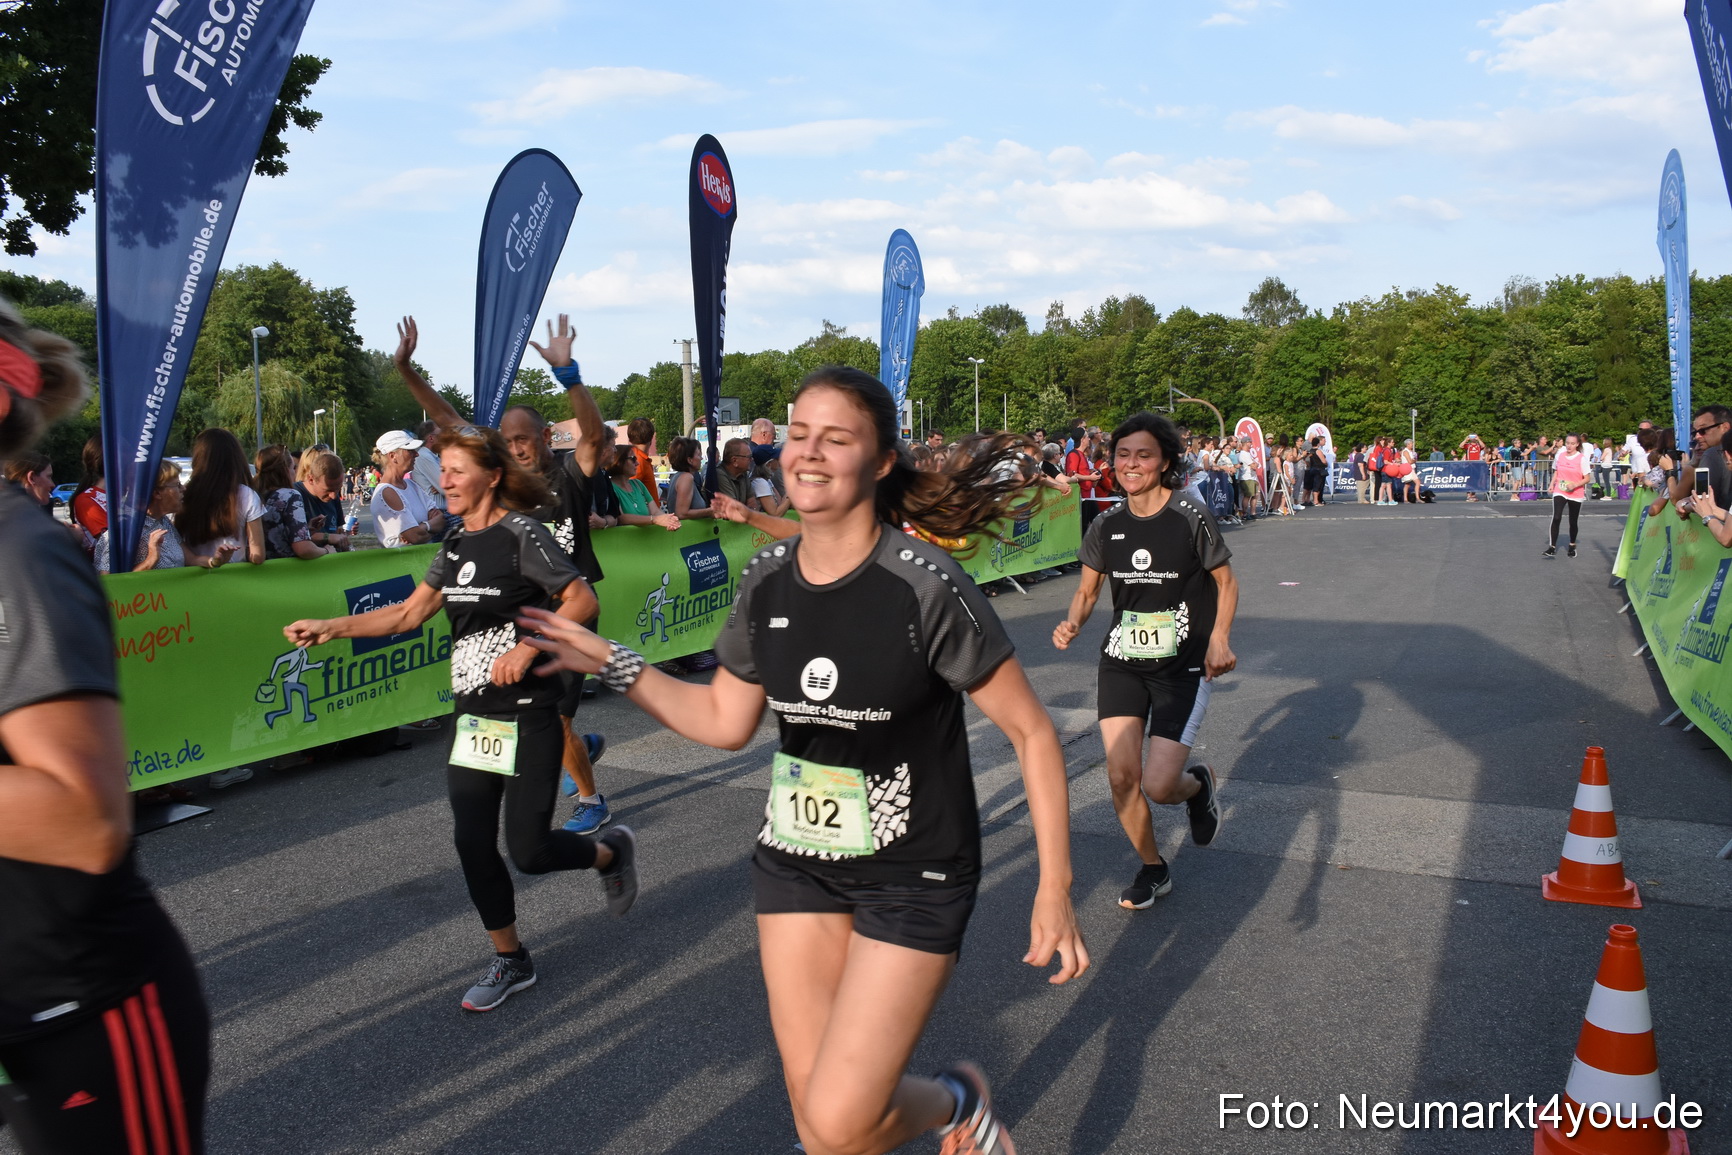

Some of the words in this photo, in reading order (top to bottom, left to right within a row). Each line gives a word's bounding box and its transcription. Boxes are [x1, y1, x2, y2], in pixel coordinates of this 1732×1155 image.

[701, 161, 731, 204] Hervis
[514, 181, 549, 259] Fischer
[528, 196, 555, 258] AUTOMOBILE
[134, 199, 223, 464] www.fischer-automobile.de
[1332, 475, 1357, 485] Fisc
[1424, 474, 1471, 484] Fischer
[694, 554, 720, 569] Fischer
[673, 614, 714, 636] neumarkt
[1130, 628, 1160, 646] 101
[327, 678, 399, 714] neumarkt
[470, 734, 502, 757] 100
[789, 791, 842, 829] 102
